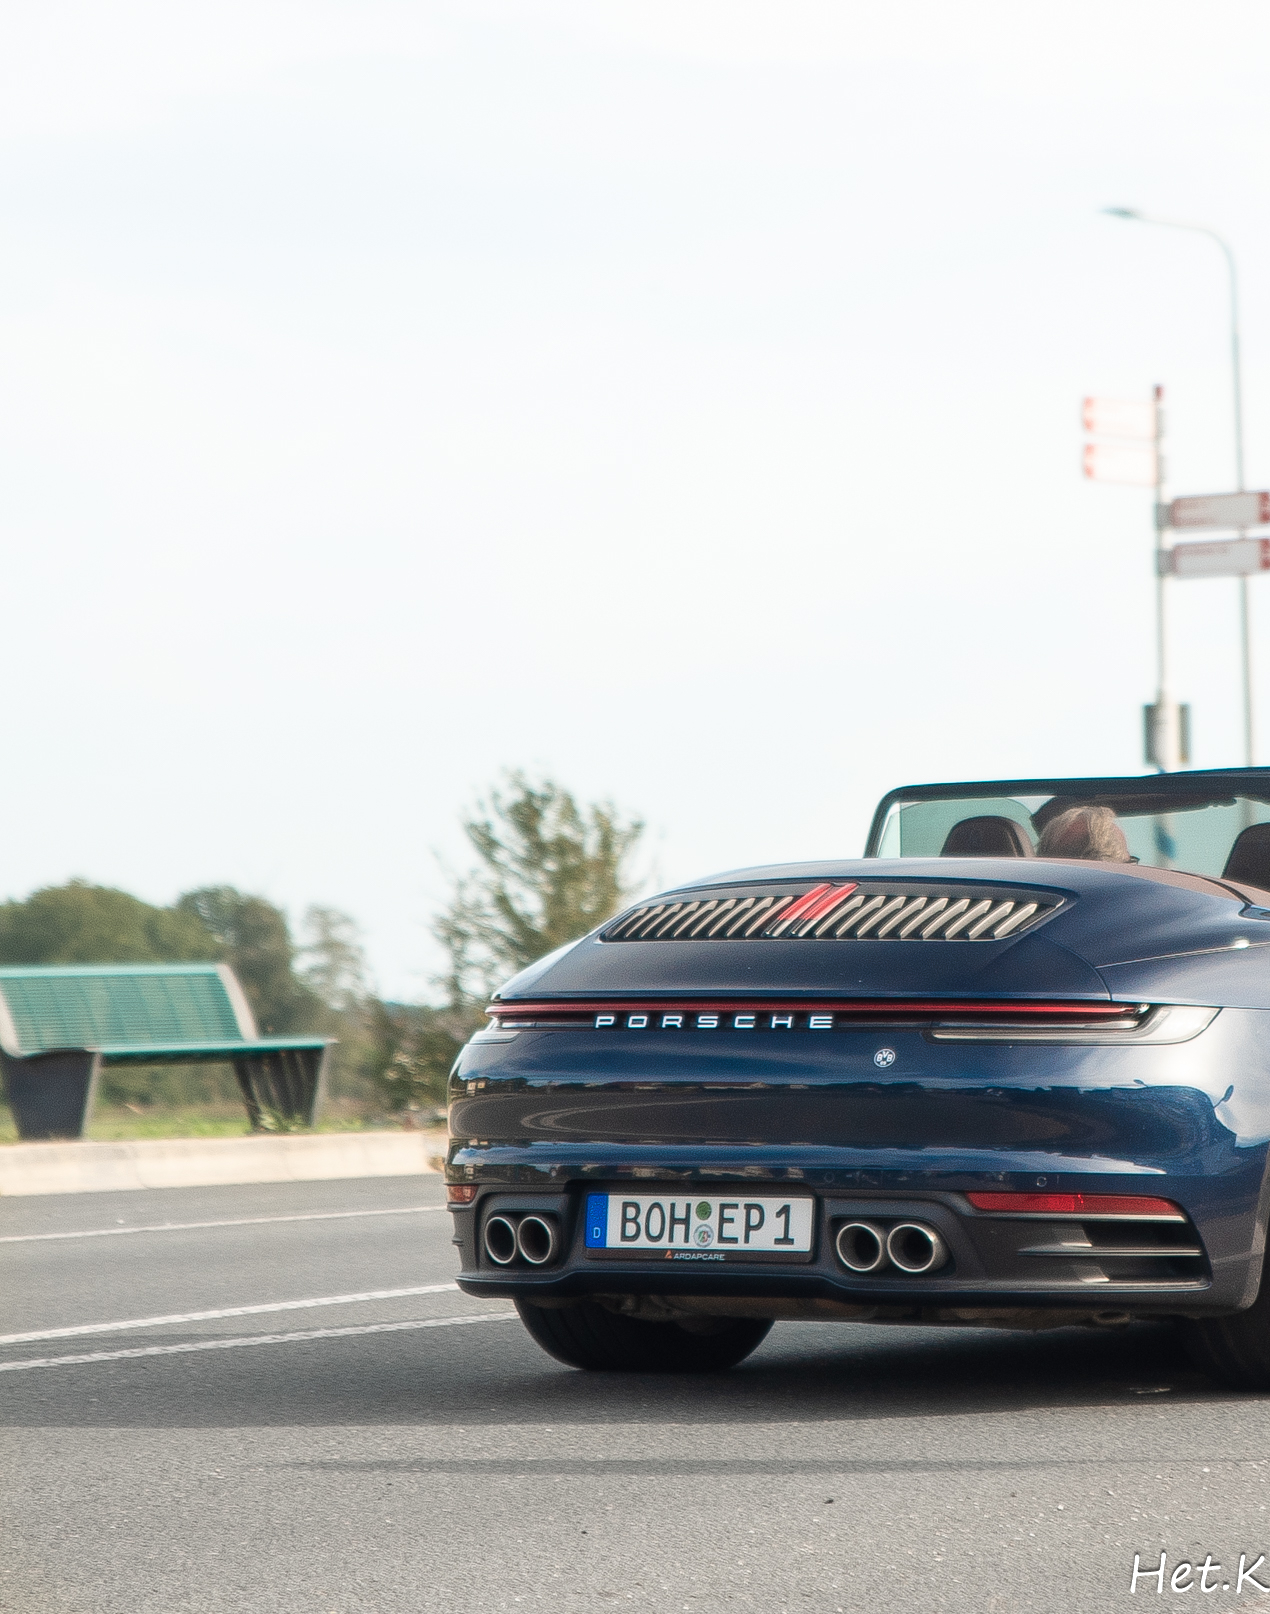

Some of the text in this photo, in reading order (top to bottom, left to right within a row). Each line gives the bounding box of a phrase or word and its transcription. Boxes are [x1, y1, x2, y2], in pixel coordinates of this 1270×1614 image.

[595, 1015, 833, 1028] PORSCHE
[877, 1051, 893, 1062] BVB
[620, 1201, 794, 1245] BOH EP 1
[593, 1227, 600, 1238] D
